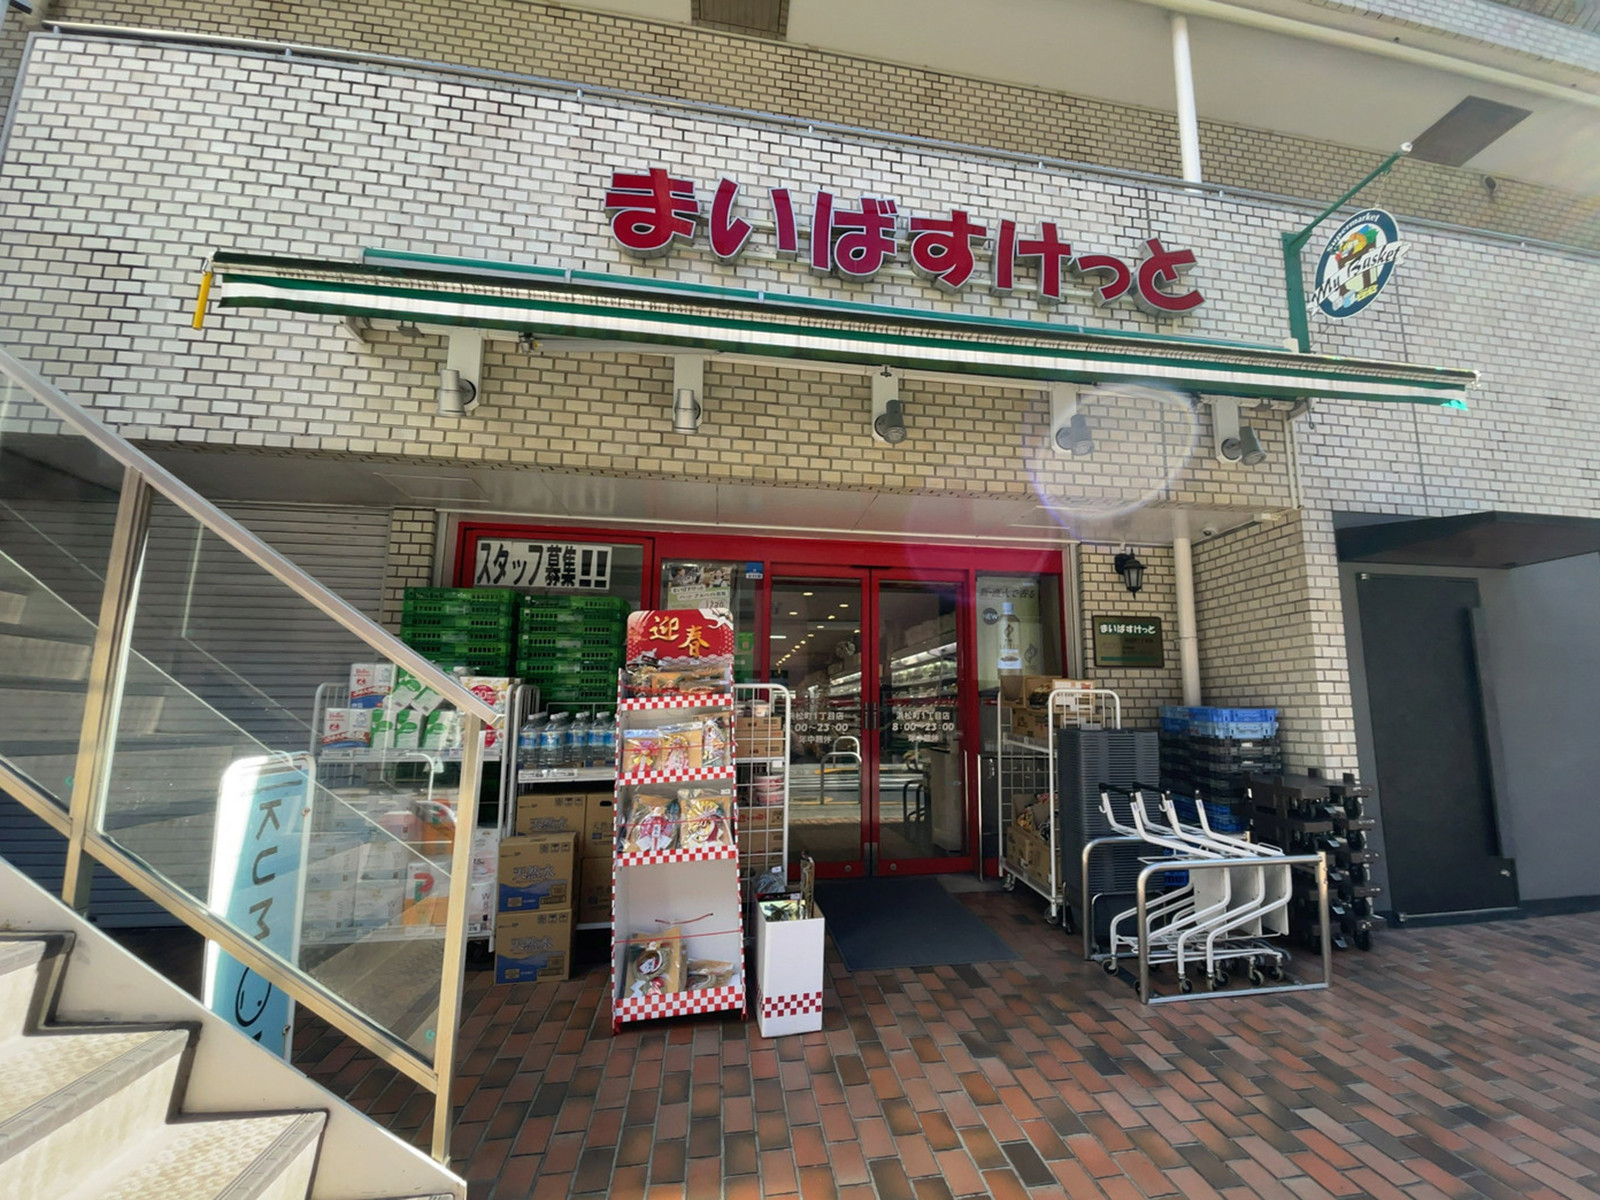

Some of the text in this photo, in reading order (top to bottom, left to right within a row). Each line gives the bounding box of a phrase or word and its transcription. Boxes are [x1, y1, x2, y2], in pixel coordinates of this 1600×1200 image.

[604, 167, 1206, 315] まいばすけっと
[1311, 245, 1401, 304] My Basket
[477, 542, 608, 588] スタッフ募集!!
[649, 615, 711, 660] 迎春
[1100, 624, 1156, 634] まいばすけっと
